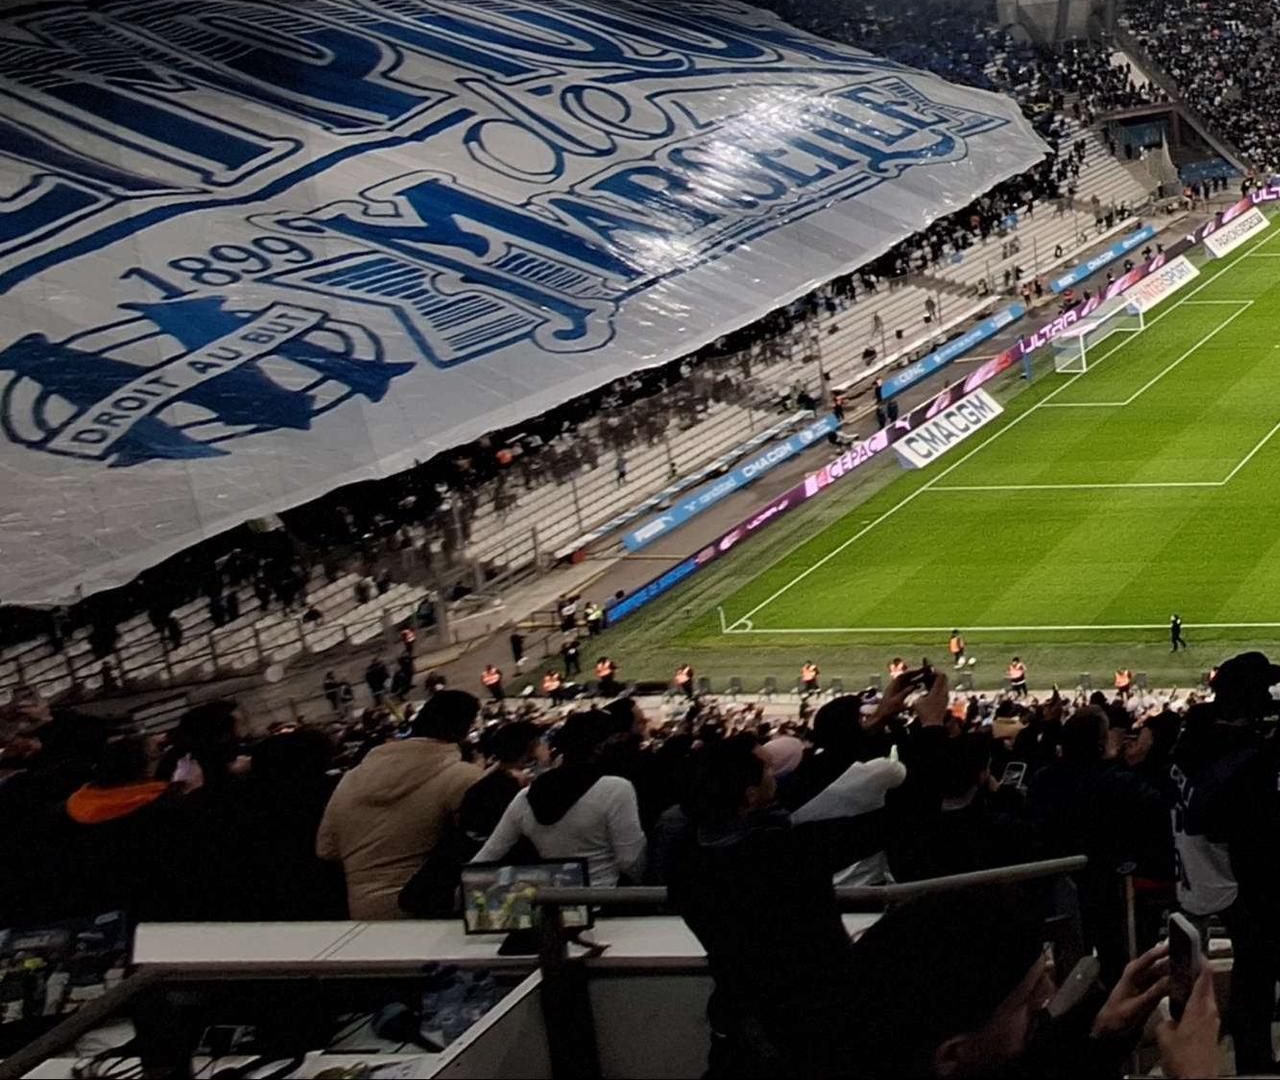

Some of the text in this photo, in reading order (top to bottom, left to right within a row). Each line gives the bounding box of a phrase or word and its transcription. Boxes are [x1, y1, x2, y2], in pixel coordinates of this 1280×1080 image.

[119, 236, 313, 300] 1899
[241, 311, 308, 346] BUT
[1020, 310, 1078, 352] ULTRA
[187, 346, 242, 375] AU
[72, 376, 180, 445] DROIT
[826, 433, 880, 481] CEPAC
